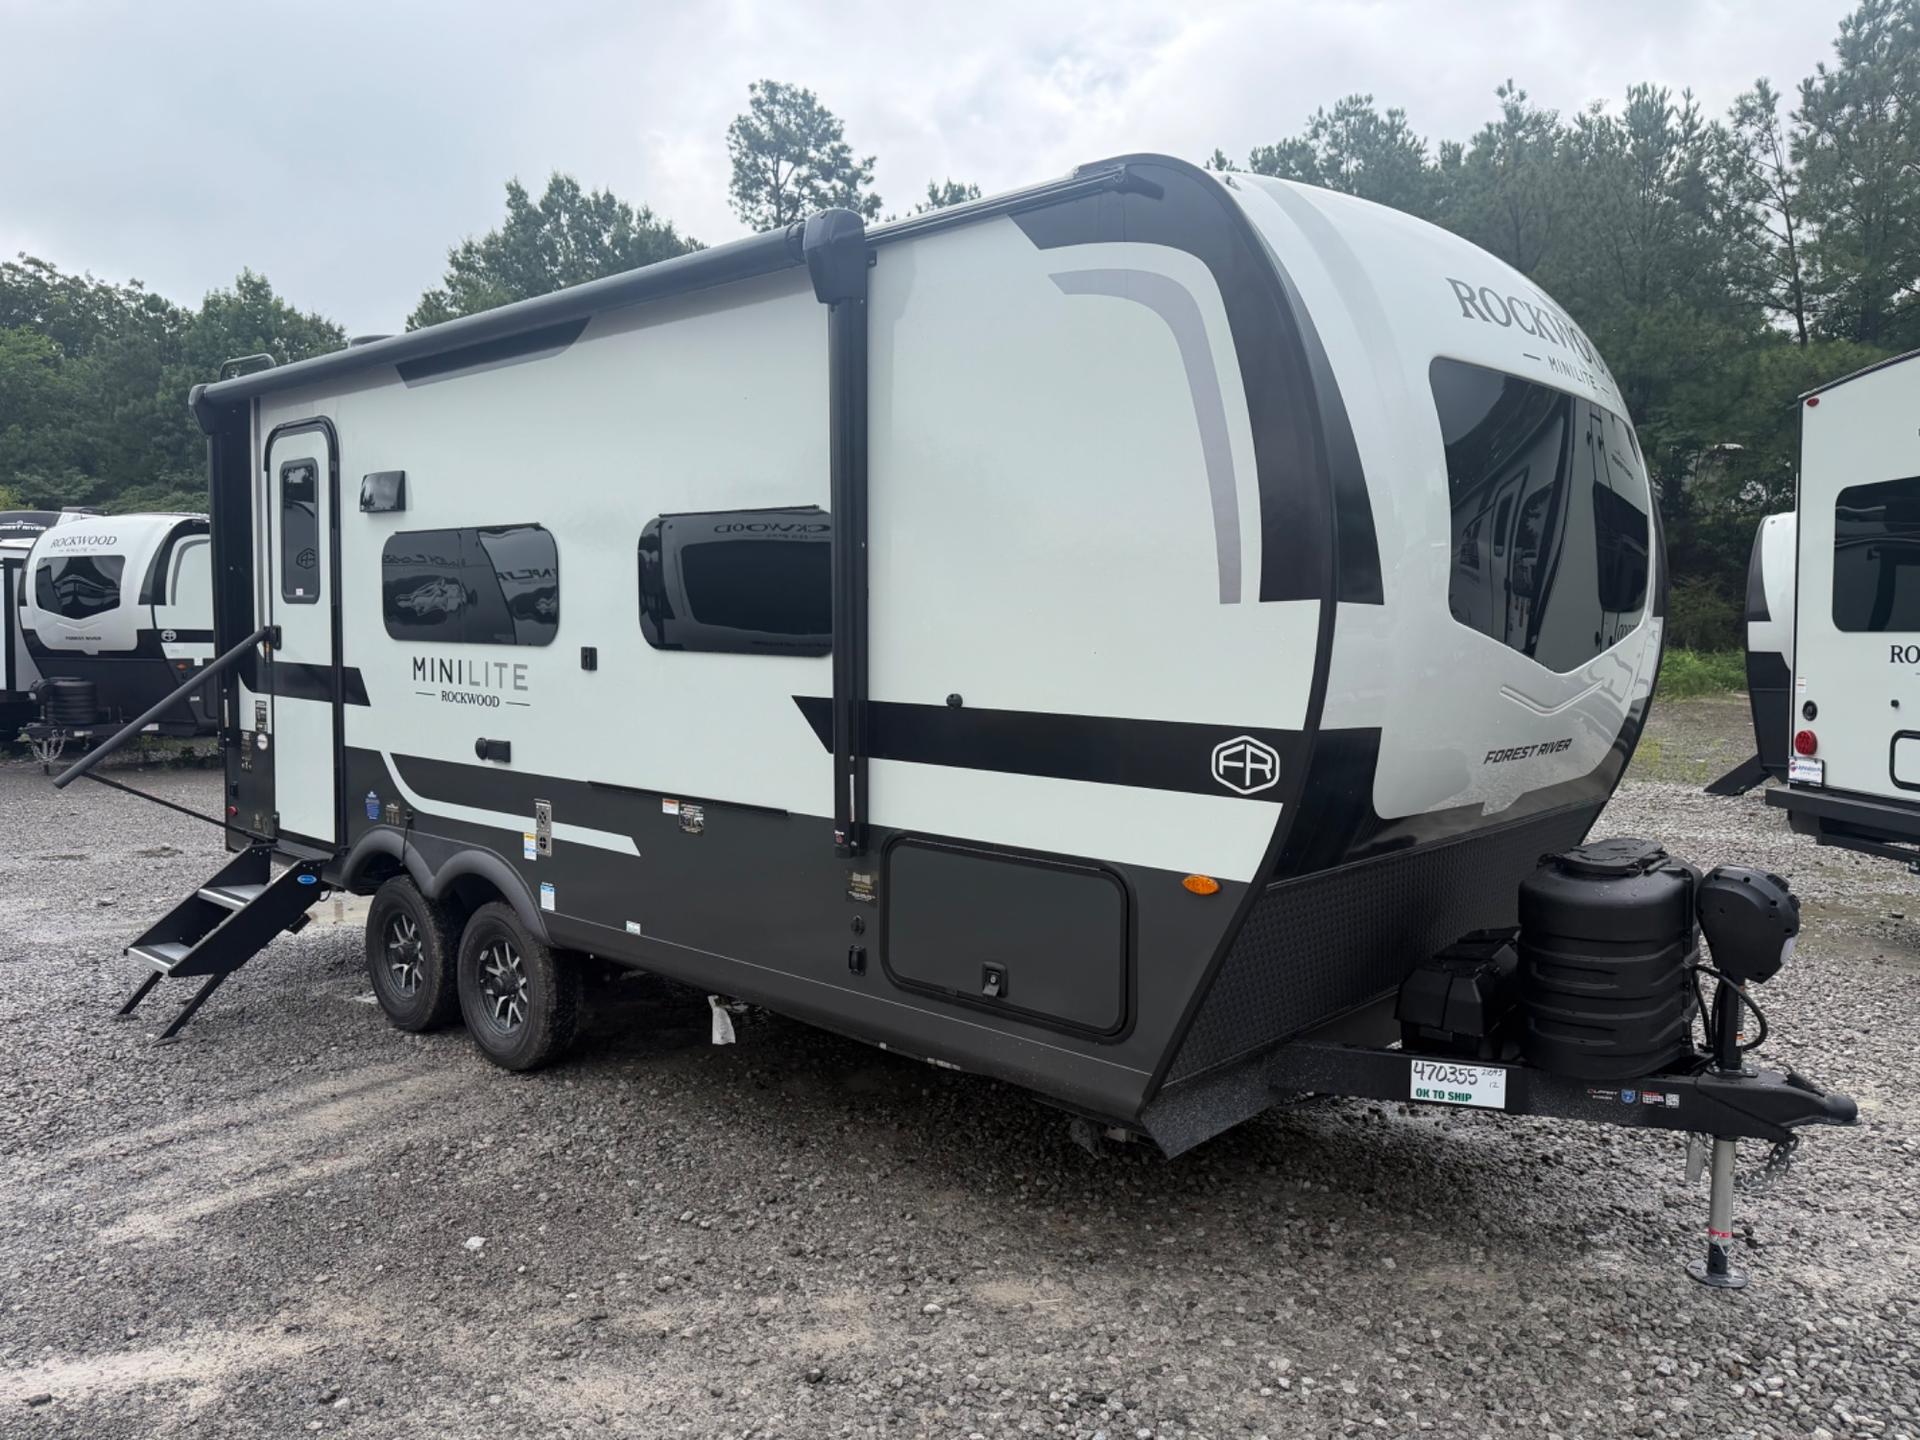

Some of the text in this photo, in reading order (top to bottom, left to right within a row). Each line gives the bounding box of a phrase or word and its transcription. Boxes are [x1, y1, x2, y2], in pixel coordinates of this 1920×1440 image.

[1446, 277, 1614, 385] ROCKWOO
[1547, 355, 1598, 391] MINILITE
[50, 535, 118, 549] ROCKWOOD
[413, 656, 528, 691] MINILITE
[441, 690, 500, 708] ROCKWOOD
[1483, 738, 1572, 765] FOREST RIVER
[1413, 1062, 1478, 1086] 470355
[1415, 1087, 1472, 1102] OK TO SHIP
